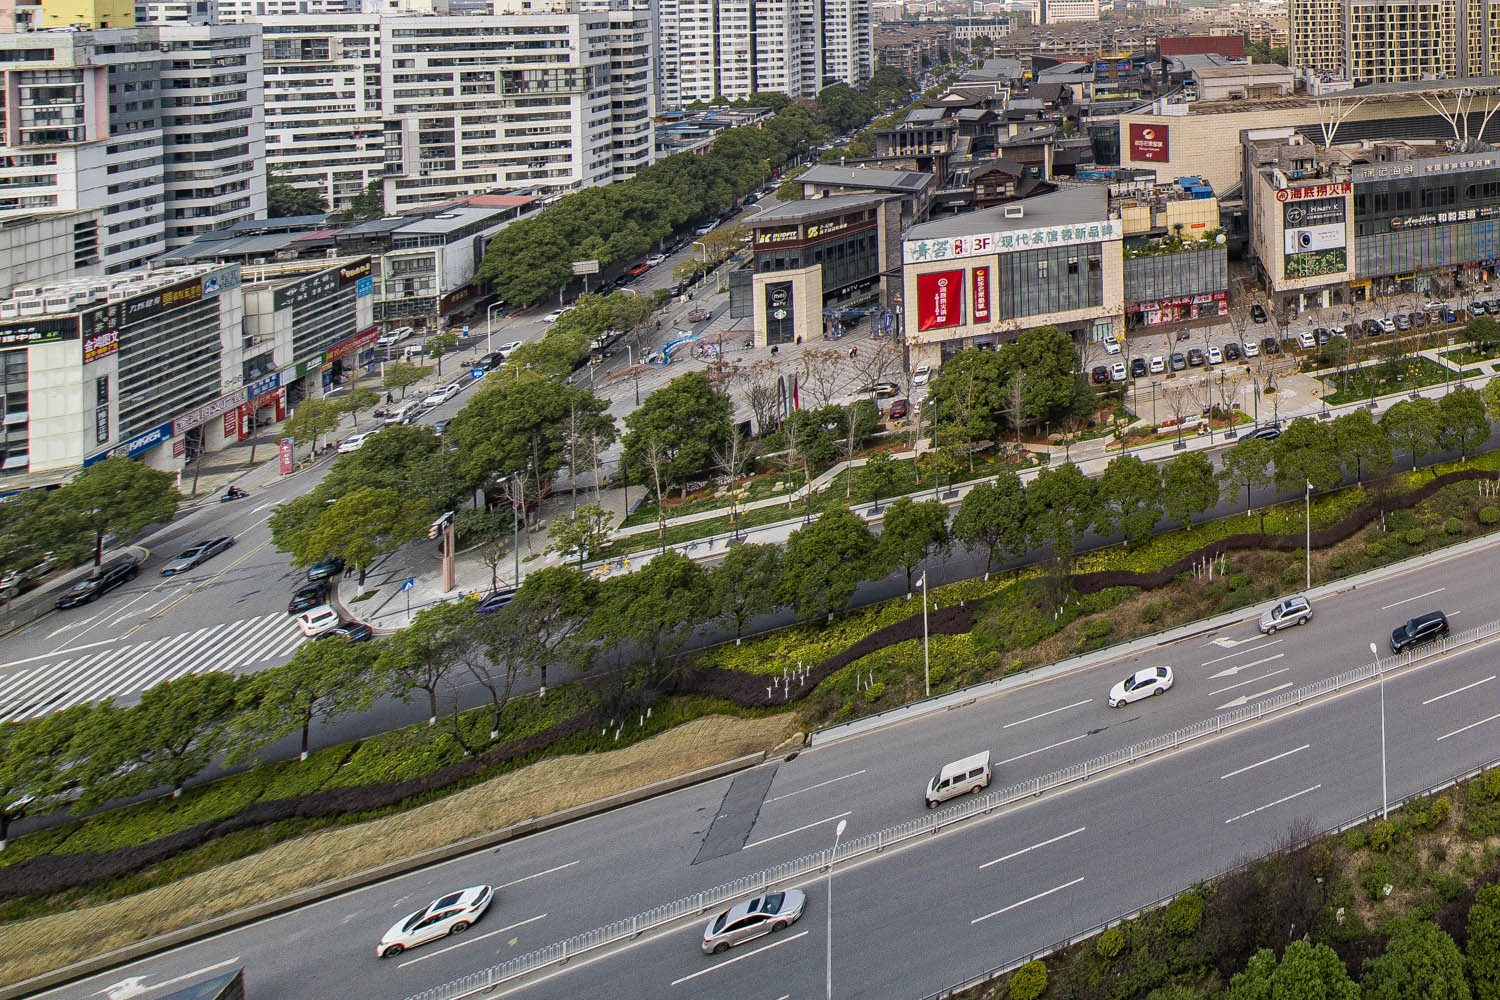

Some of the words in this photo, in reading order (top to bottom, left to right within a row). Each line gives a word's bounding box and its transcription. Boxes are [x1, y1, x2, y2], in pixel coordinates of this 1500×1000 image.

[1291, 183, 1352, 200] 海底捞火锅
[974, 238, 990, 250] 3F
